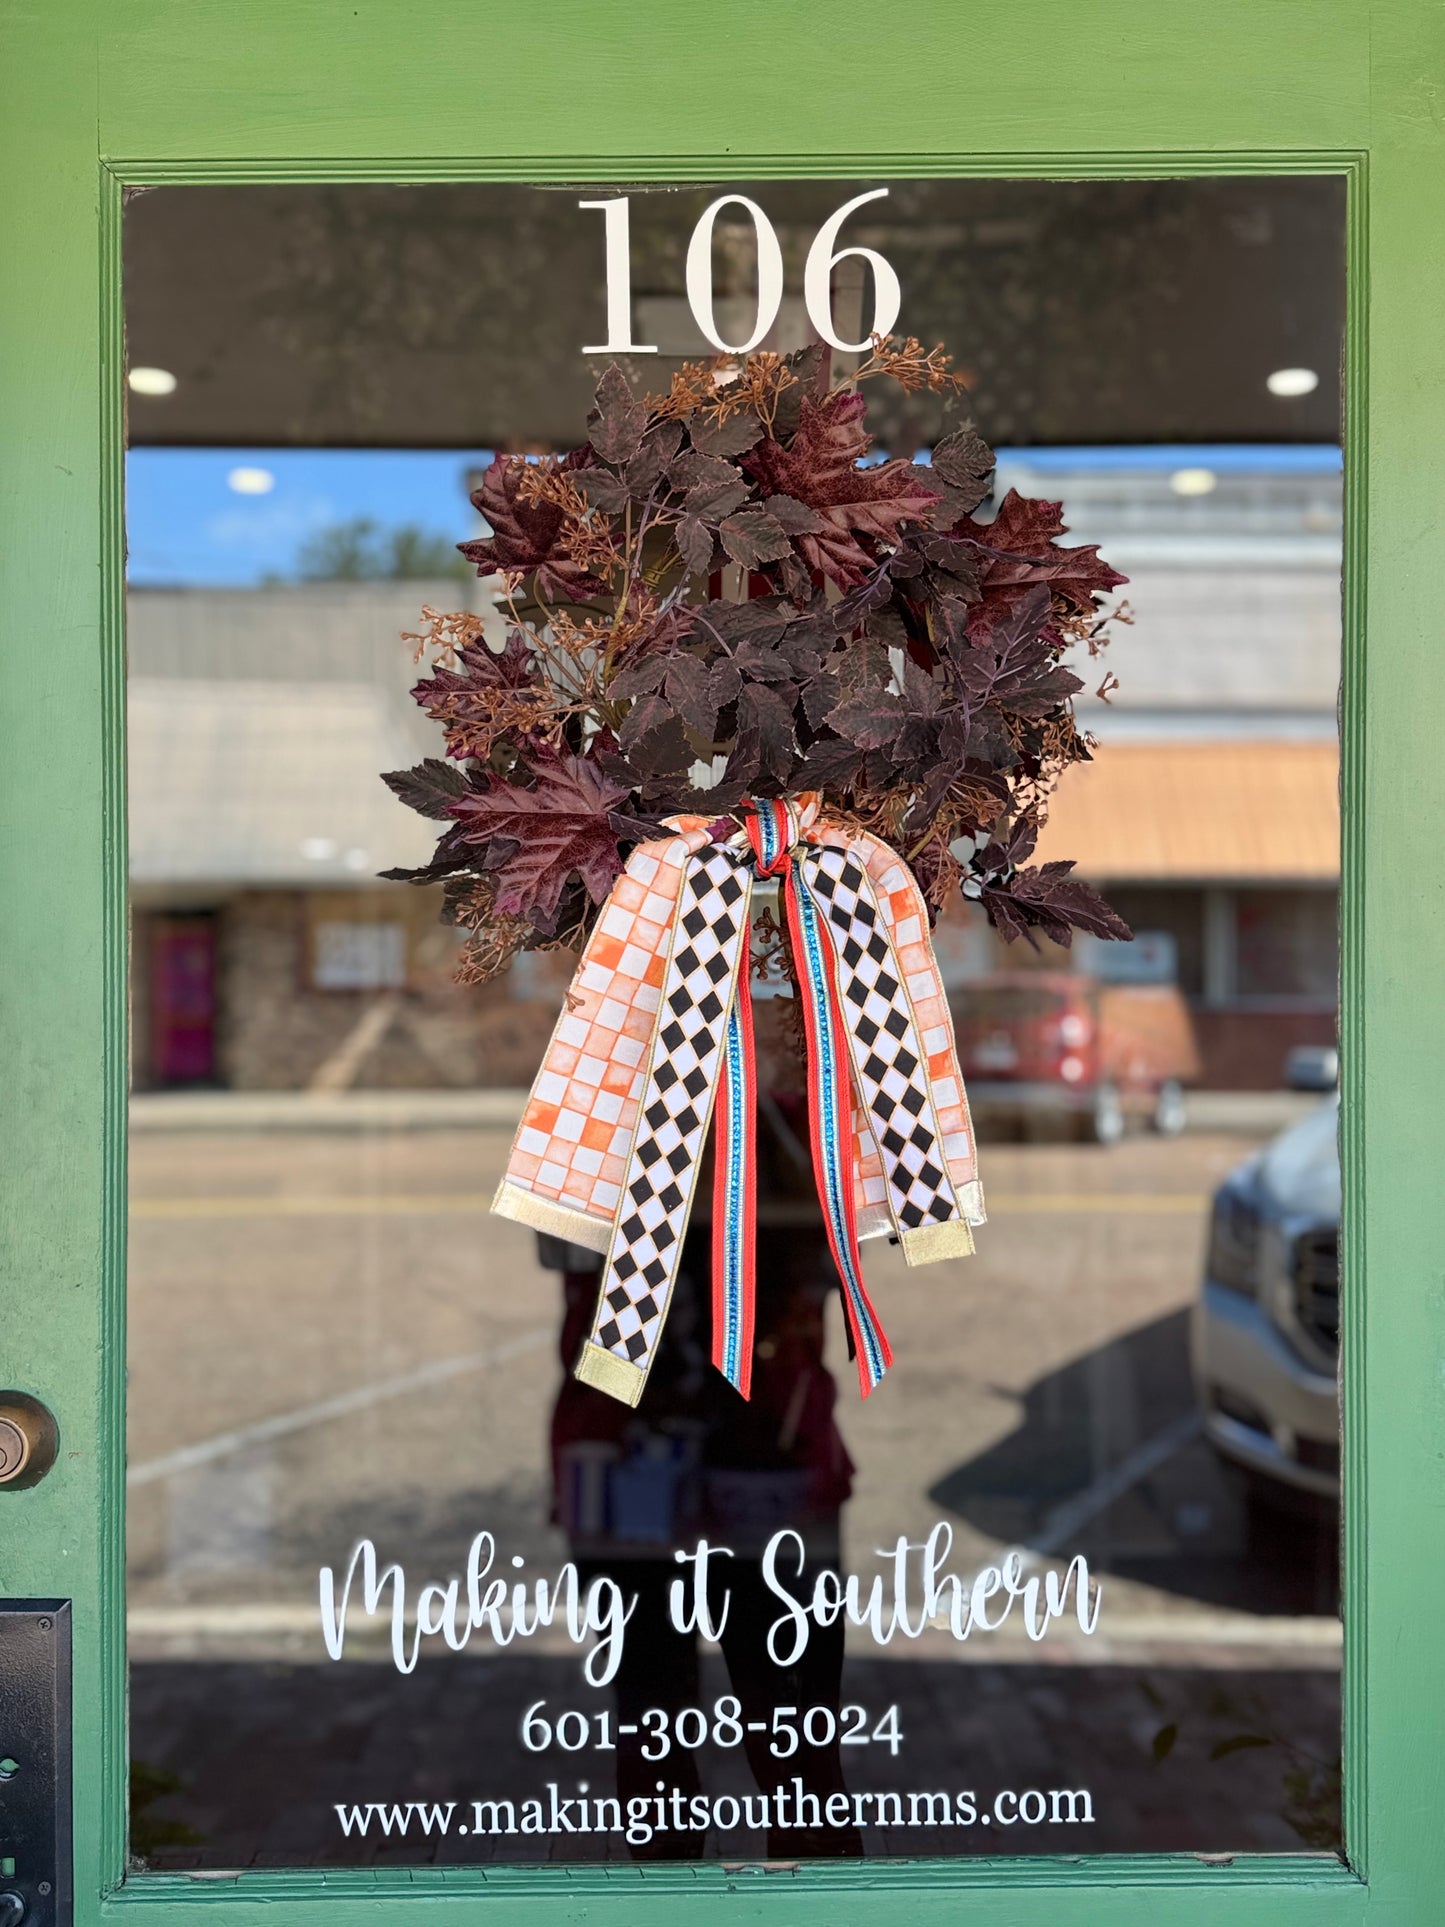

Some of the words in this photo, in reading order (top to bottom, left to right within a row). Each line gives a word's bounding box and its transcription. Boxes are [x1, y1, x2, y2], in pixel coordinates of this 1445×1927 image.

[579, 188, 901, 354] 106
[319, 1531, 639, 1687] Making
[671, 1539, 735, 1644] it
[762, 1521, 1101, 1667] Southern
[521, 1696, 904, 1760] 601-308-5024
[334, 1778, 1095, 1845] www.makingitsouthernms.com
